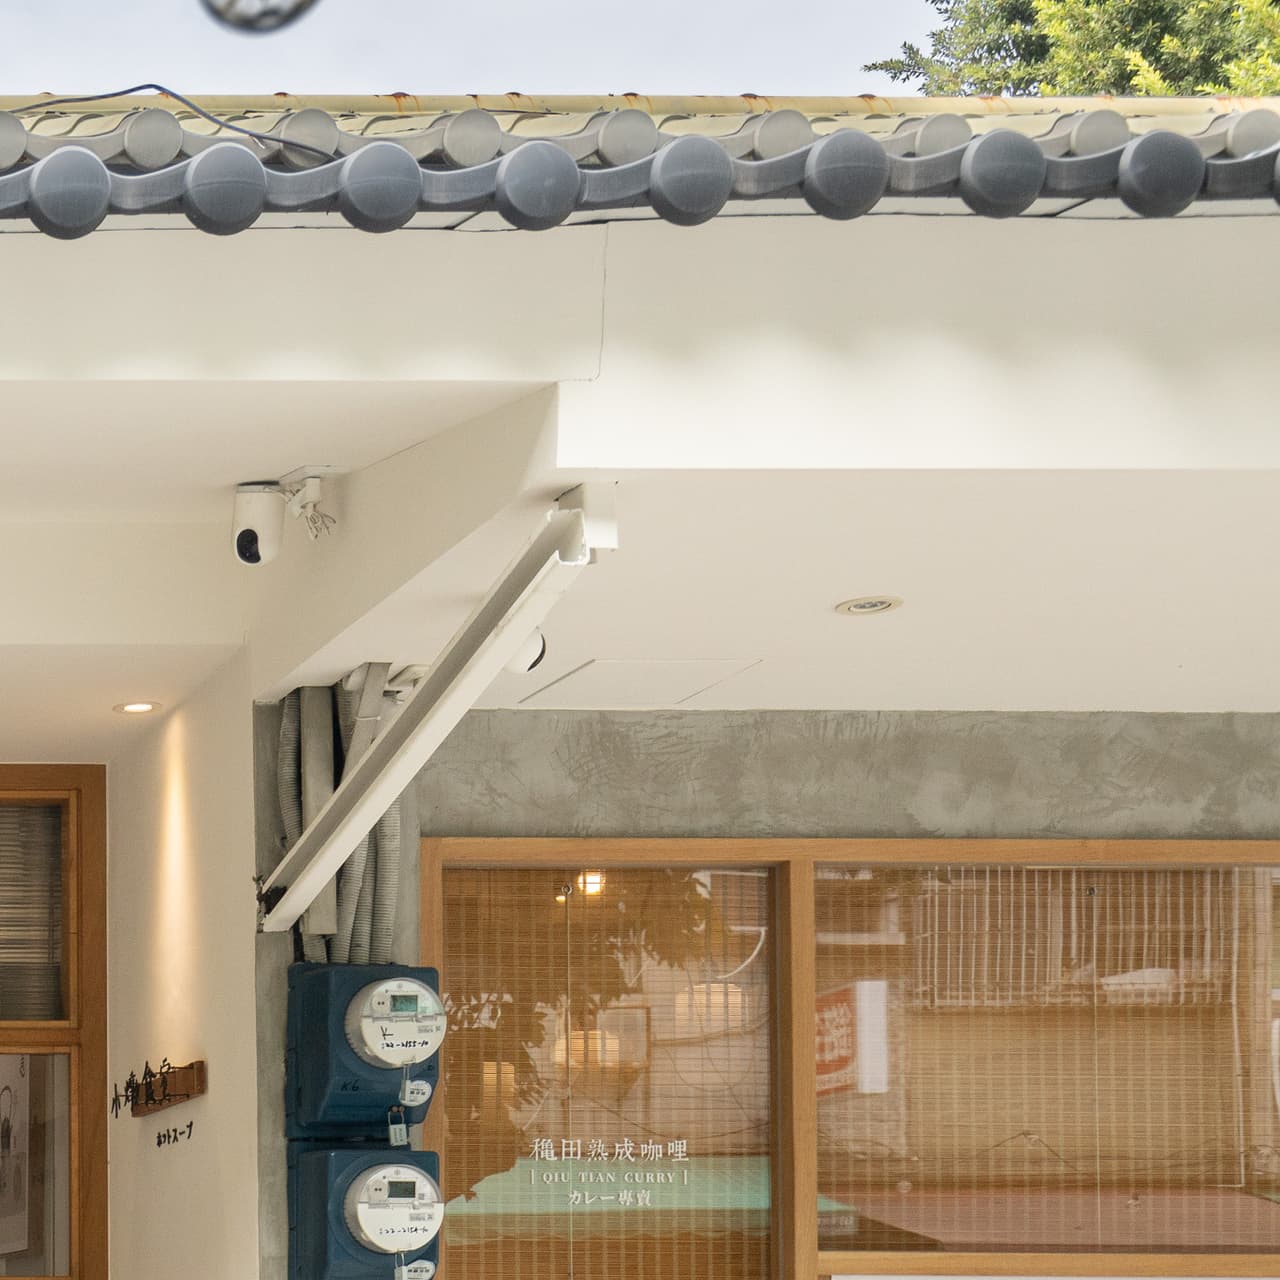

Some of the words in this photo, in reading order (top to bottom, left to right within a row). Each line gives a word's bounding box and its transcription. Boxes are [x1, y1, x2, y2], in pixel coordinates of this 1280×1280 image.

[543, 1172, 569, 1184] QIU
[578, 1172, 616, 1184] TIAN
[624, 1172, 675, 1184] CURRY
